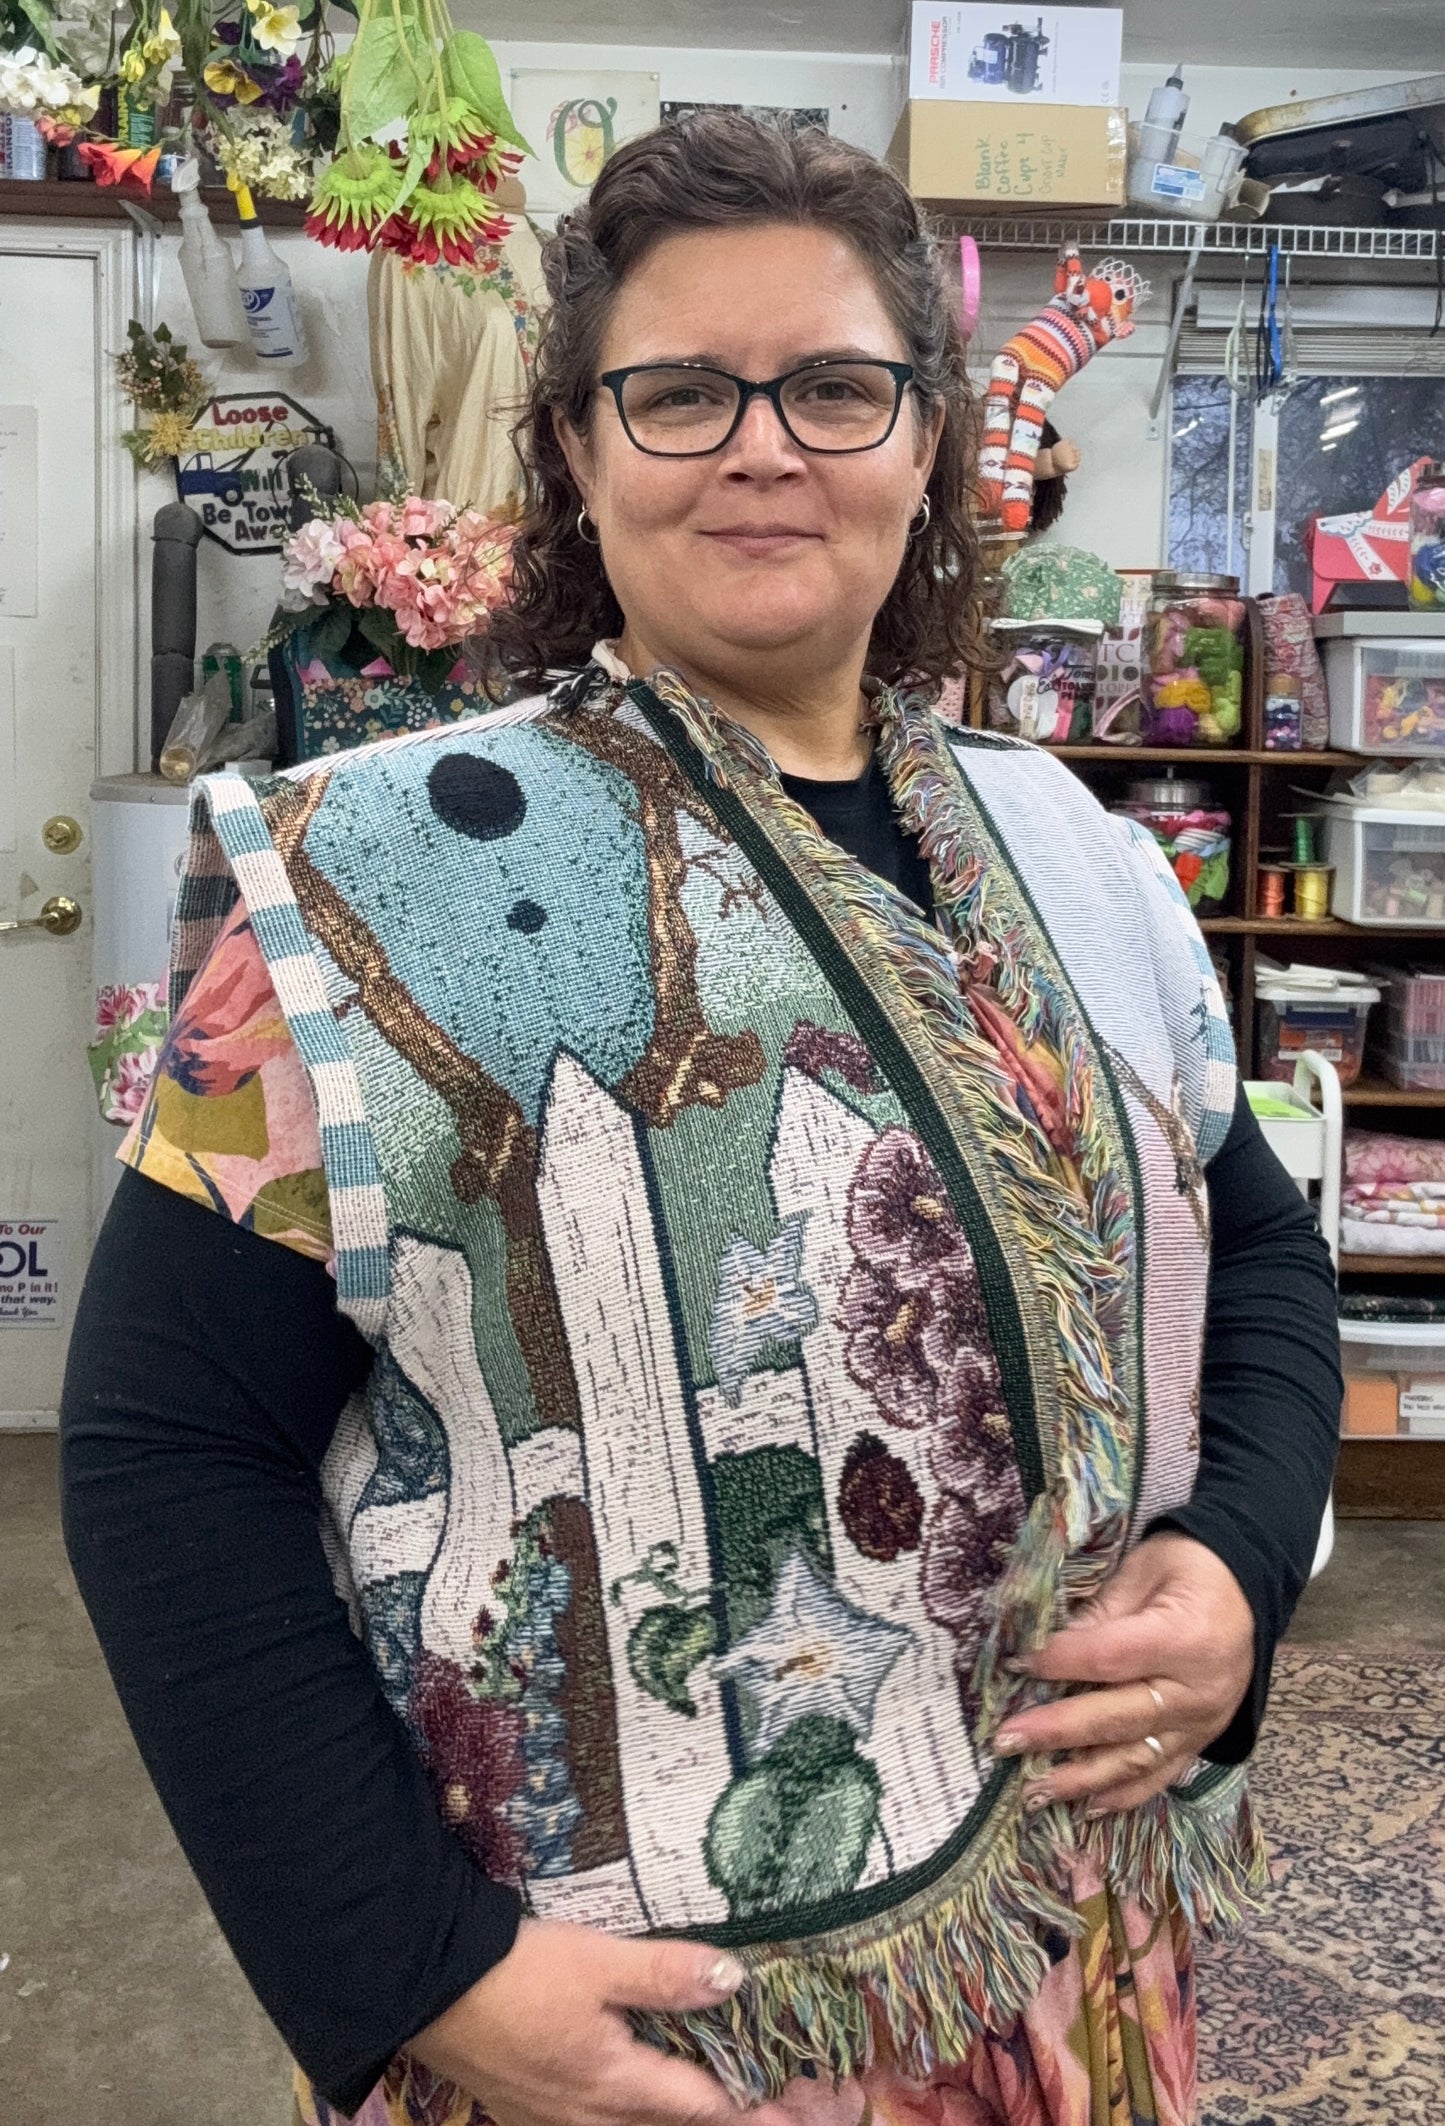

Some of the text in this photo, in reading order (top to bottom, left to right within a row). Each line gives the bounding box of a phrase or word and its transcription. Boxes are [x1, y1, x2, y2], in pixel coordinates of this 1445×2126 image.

[1015, 132, 1034, 144] 4
[975, 133, 992, 190] Blank
[212, 404, 289, 426] Loose
[195, 425, 309, 451] Children
[239, 468, 283, 492] Will
[202, 501, 293, 525] Be Tow
[18, 1223, 47, 1235] Our
[18, 1282, 26, 1292] P
[31, 1282, 41, 1293] in
[1, 1294, 57, 1306] that way.
